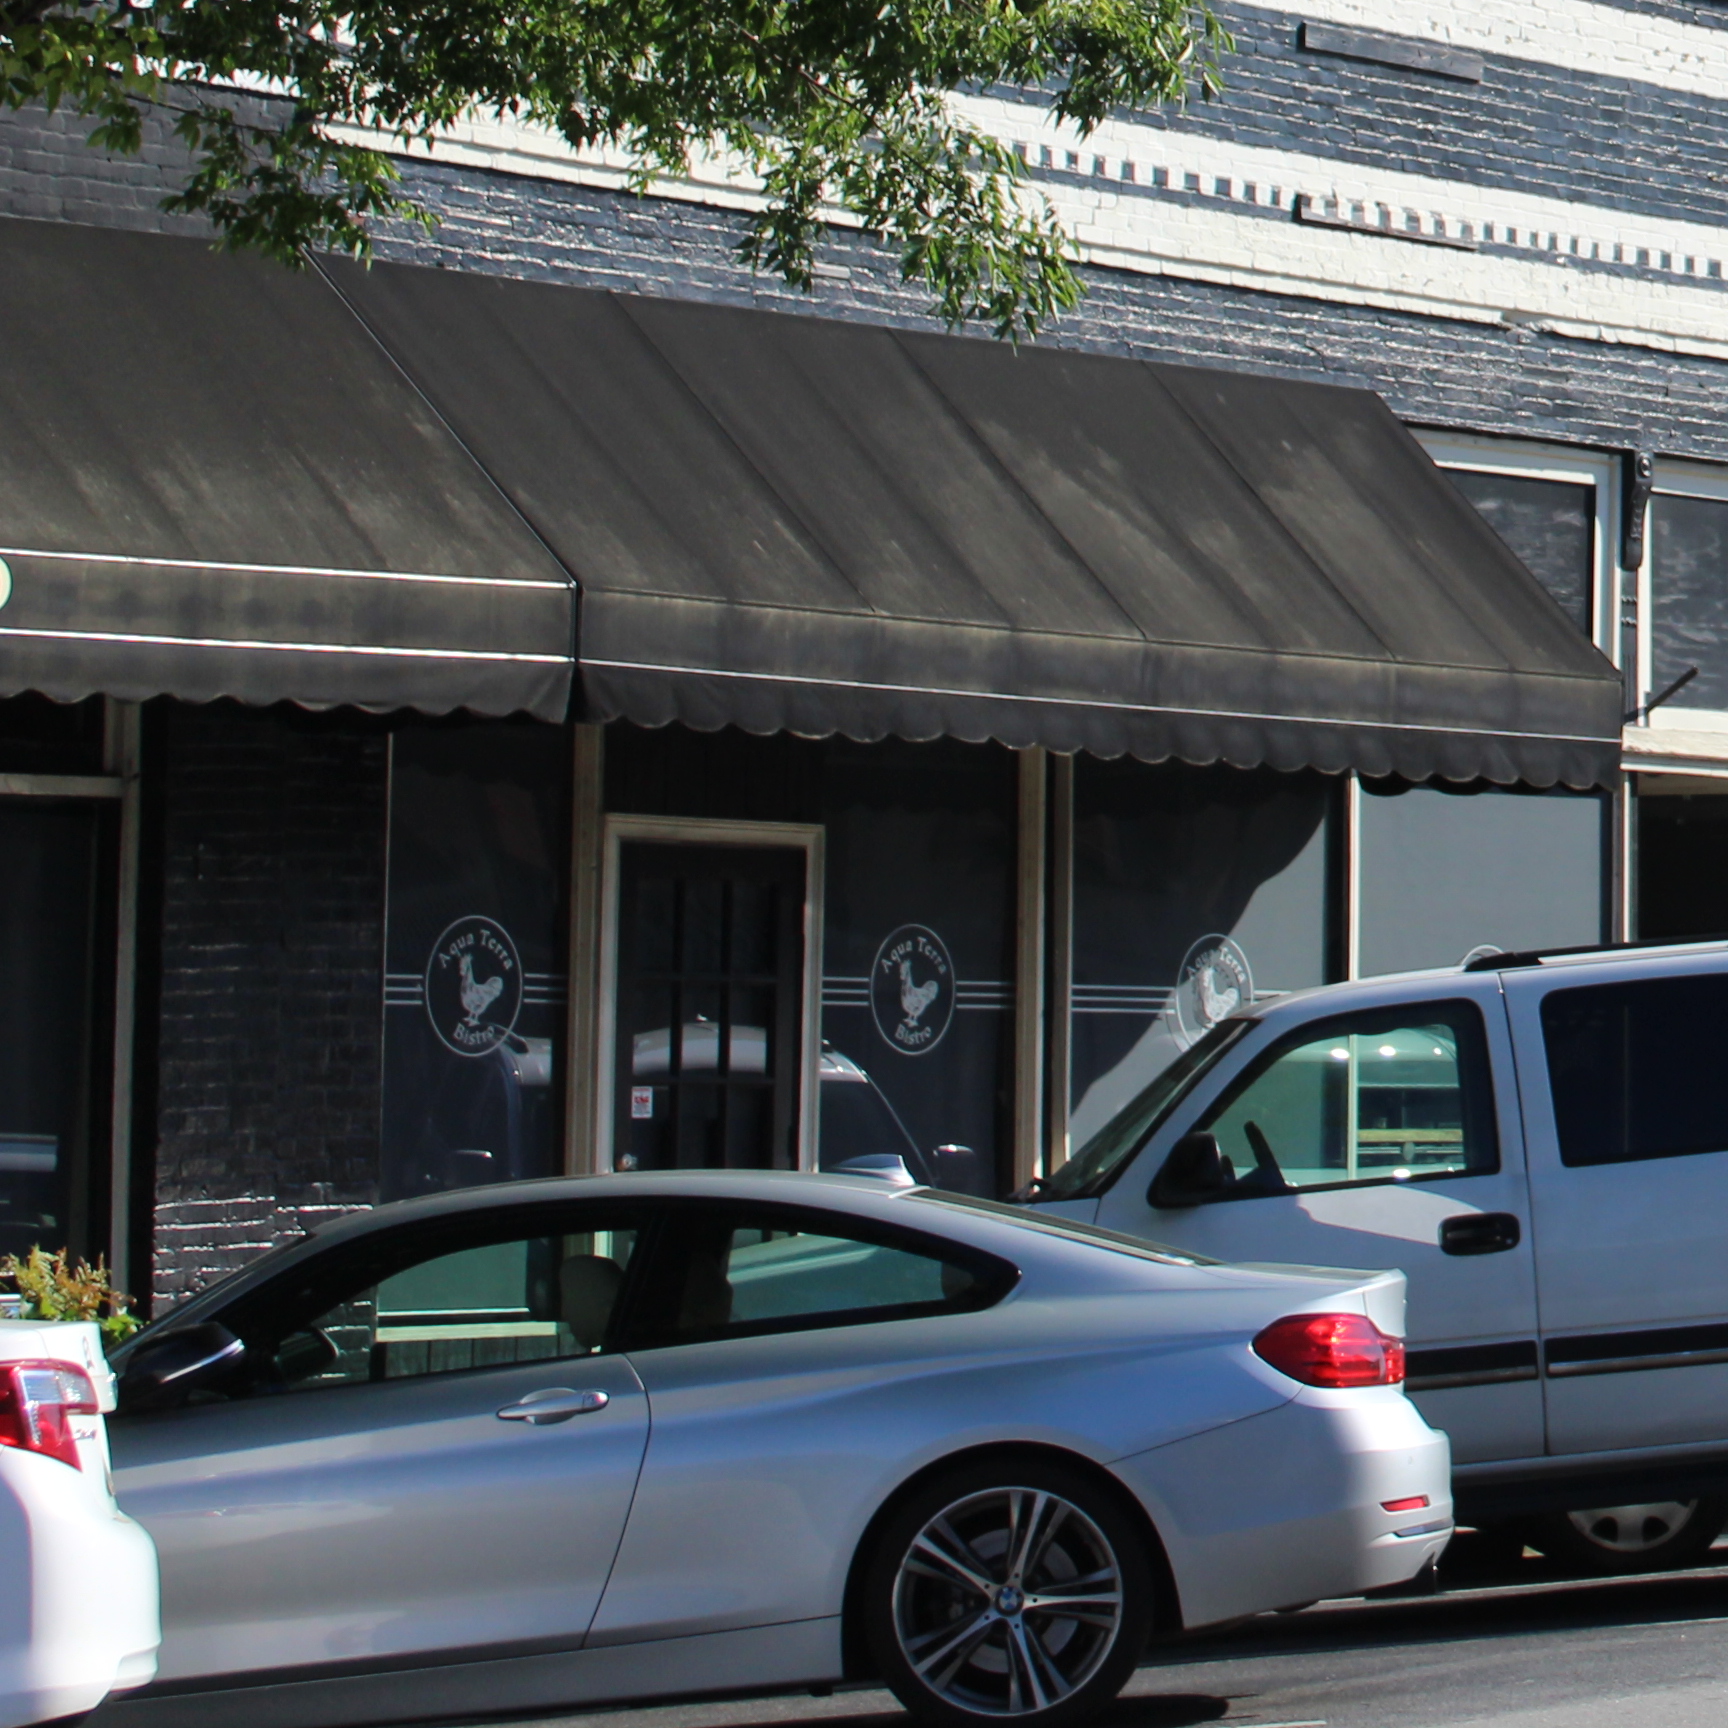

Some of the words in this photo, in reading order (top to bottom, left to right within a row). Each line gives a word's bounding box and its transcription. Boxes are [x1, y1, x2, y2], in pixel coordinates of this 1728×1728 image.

[438, 932, 476, 970] Aqua
[479, 928, 514, 970] Terra
[881, 939, 913, 974] Aqua
[917, 936, 947, 974] Terra
[1219, 946, 1246, 984] Terra
[452, 1022, 495, 1046] Bistro
[894, 1022, 932, 1045] Bistro
